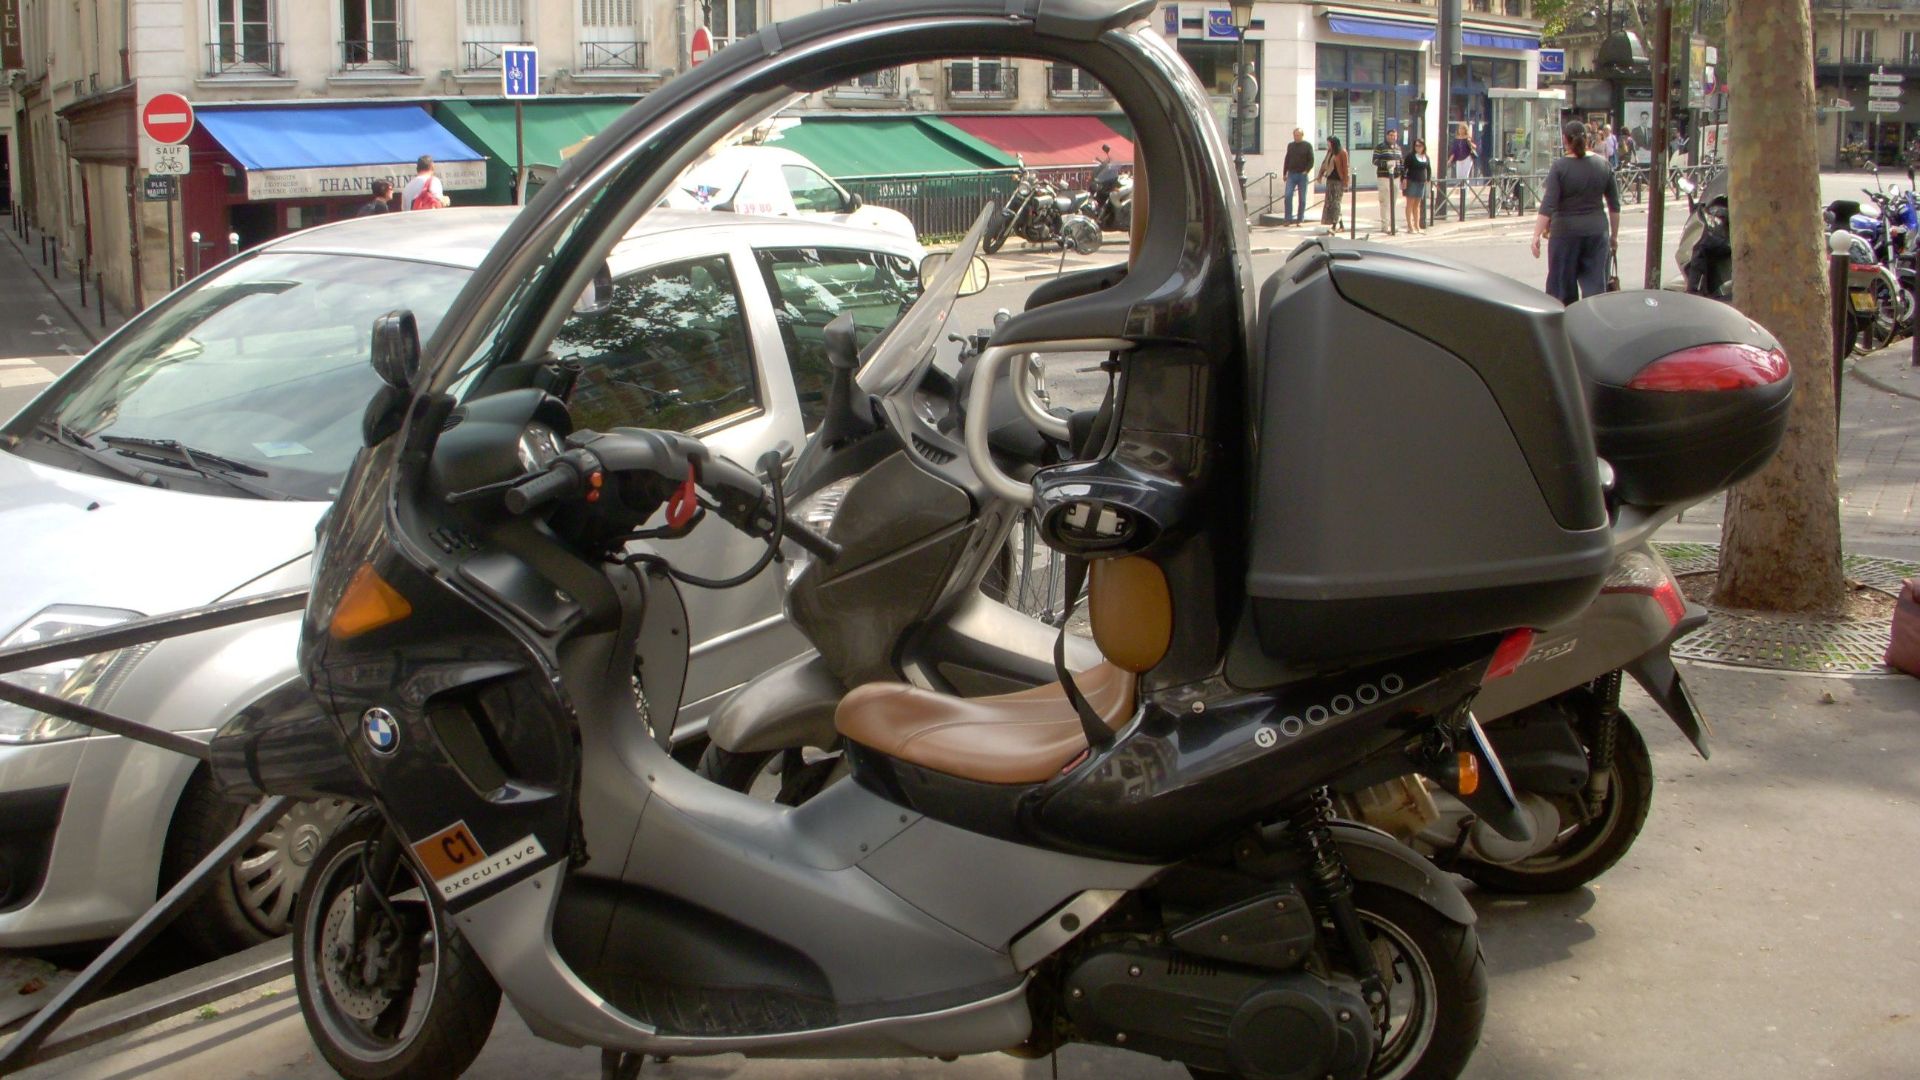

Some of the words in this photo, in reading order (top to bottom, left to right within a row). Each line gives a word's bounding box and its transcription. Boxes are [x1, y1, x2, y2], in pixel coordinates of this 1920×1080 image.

[155, 147, 182, 155] SAUF
[319, 176, 375, 192] THANH
[385, 175, 418, 189] BIN
[147, 188, 177, 196] MAUBET
[1257, 730, 1275, 744] C1
[441, 830, 478, 864] C1
